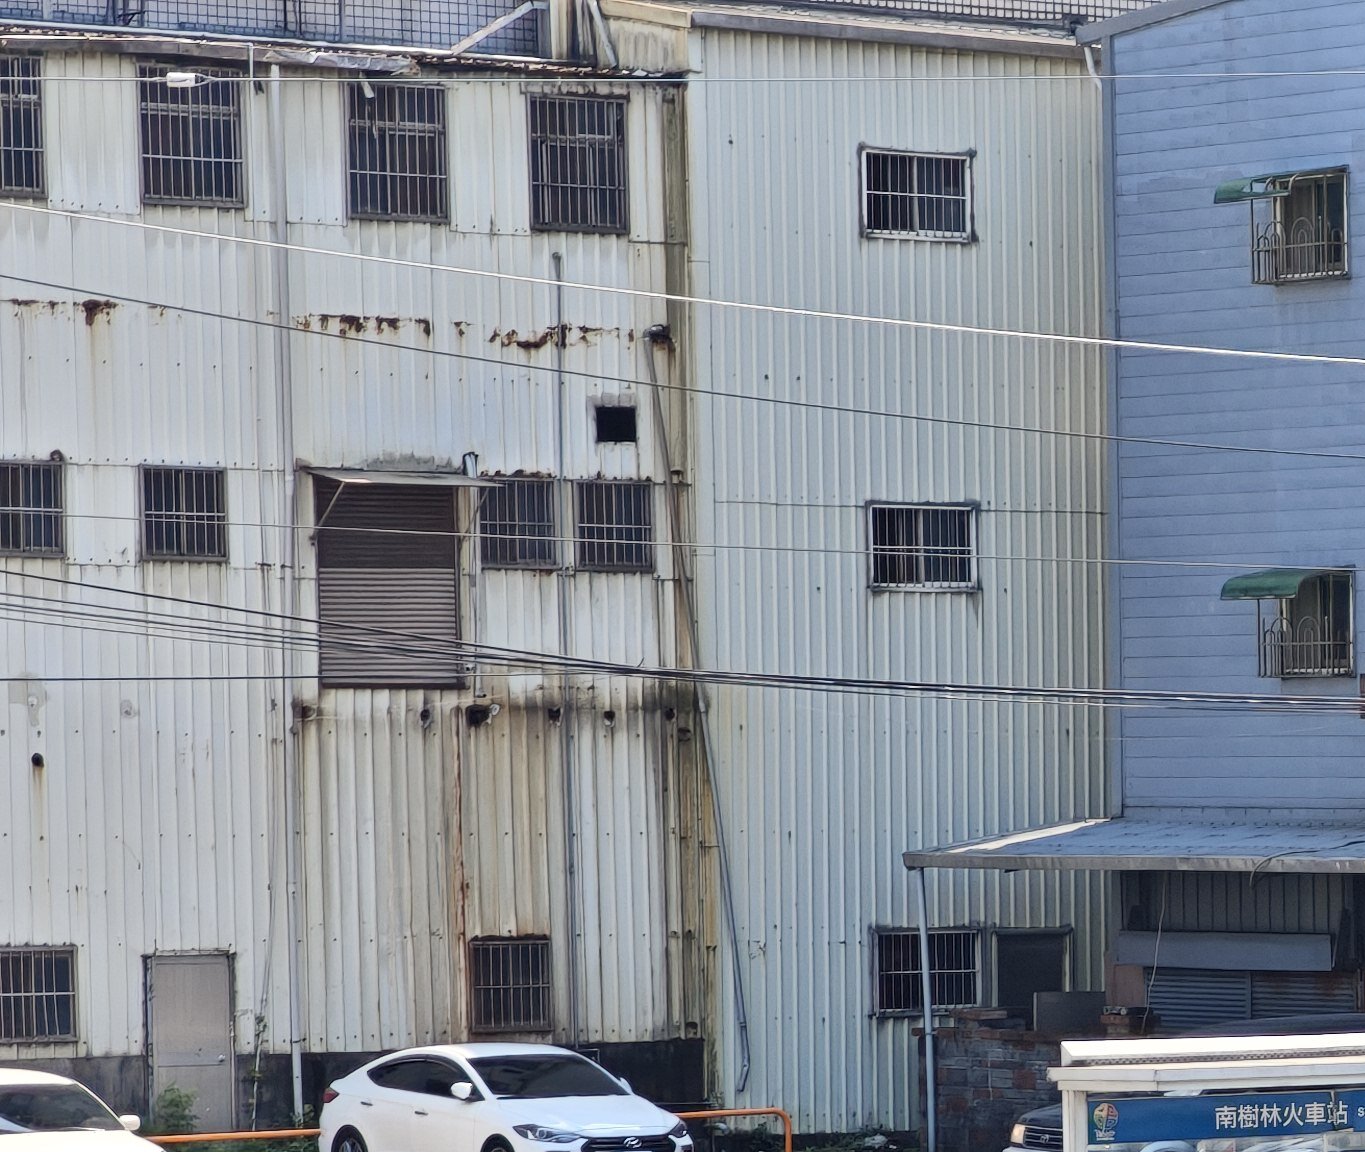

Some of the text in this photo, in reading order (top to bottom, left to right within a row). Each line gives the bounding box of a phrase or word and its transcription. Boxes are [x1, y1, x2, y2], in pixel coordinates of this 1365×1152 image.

[1214, 1100, 1349, 1131] 南樹林火車站
